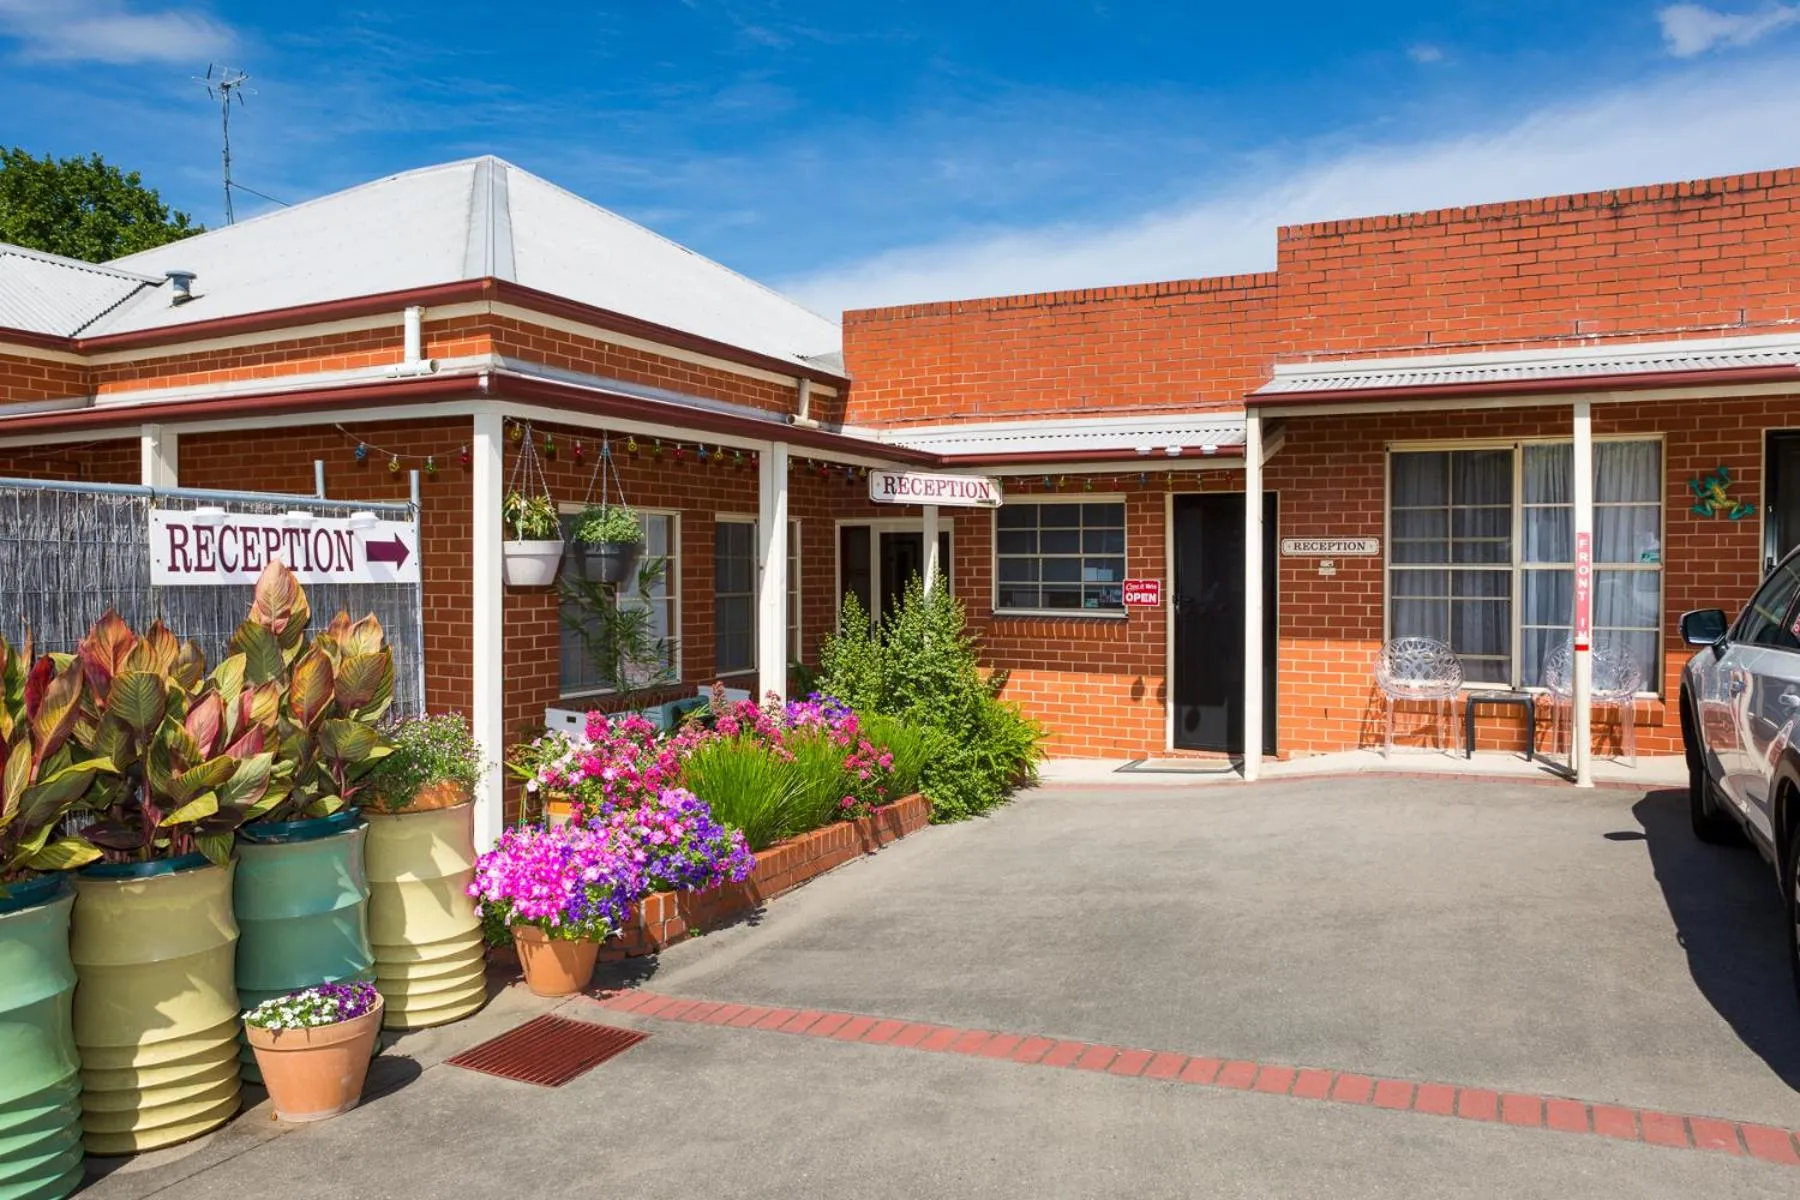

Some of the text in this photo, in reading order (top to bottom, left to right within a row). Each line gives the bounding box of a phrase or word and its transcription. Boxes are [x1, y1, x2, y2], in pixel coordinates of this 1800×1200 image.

[882, 475, 991, 499] RECEPTION
[165, 523, 355, 574] RECEPTION
[1293, 541, 1367, 552] RECEPTION
[1578, 539, 1589, 601] FRONT
[1125, 592, 1157, 603] OPEN
